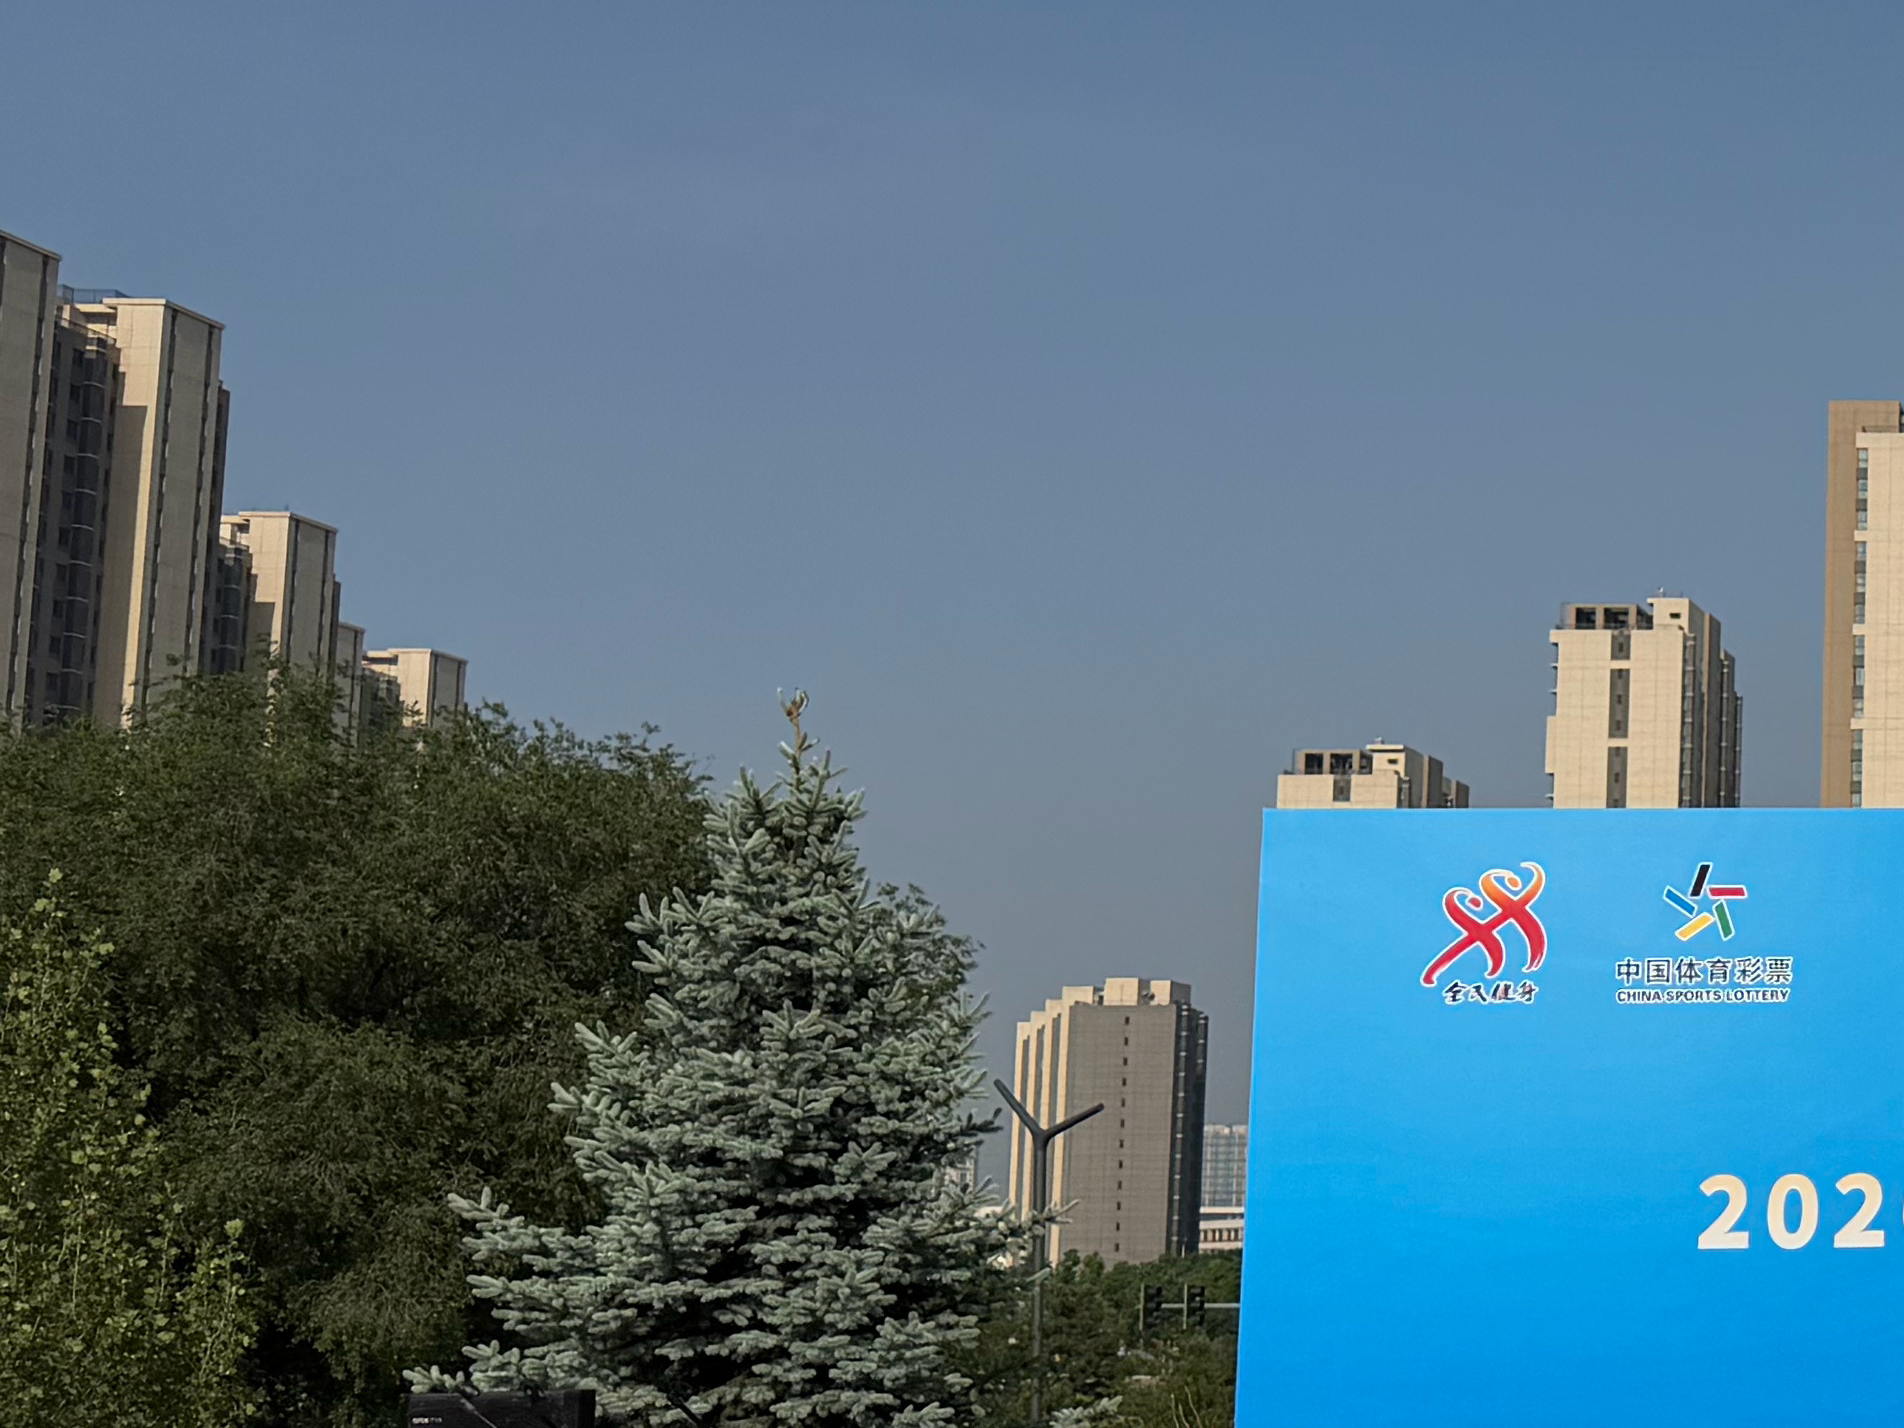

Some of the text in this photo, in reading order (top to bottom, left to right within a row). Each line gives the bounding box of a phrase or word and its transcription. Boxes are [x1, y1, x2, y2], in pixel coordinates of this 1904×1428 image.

[1615, 956, 1793, 985] 中国体育彩票
[1616, 988, 1791, 1004] CHINA SPORTS LOTTERY
